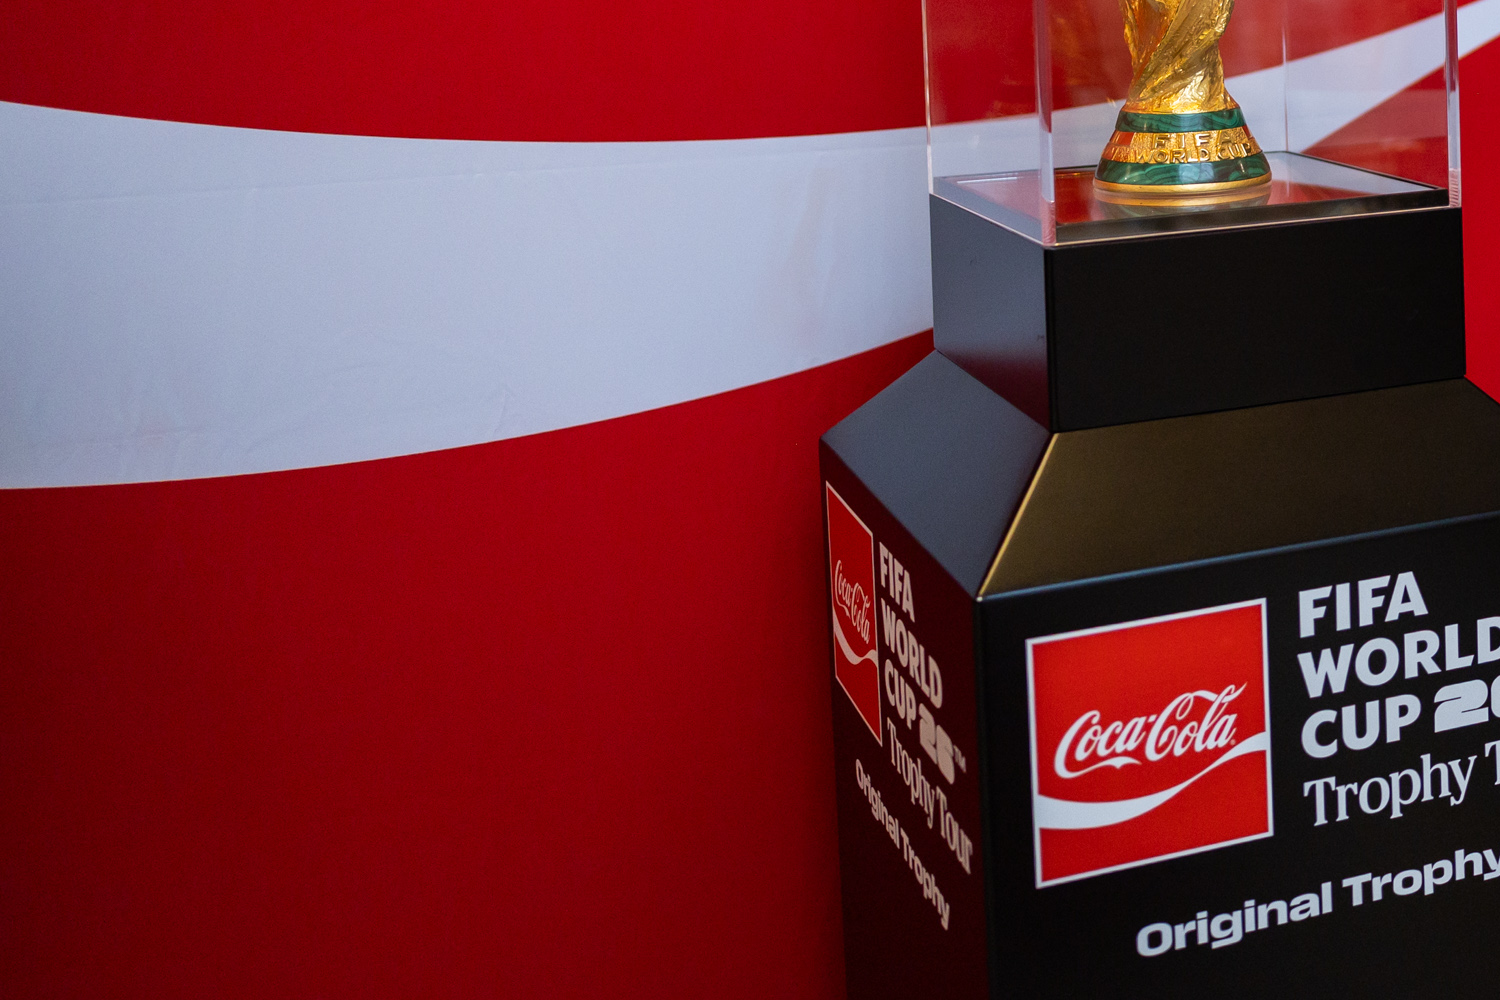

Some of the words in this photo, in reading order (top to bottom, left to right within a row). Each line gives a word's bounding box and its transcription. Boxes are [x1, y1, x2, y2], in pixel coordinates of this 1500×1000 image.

[1134, 147, 1210, 163] WORLD
[1217, 142, 1252, 160] CUP
[1153, 132, 1236, 149] FIFA
[834, 559, 871, 645] Coca-Cola
[878, 541, 915, 623] FIFA
[1298, 571, 1429, 638] FIFA
[880, 597, 943, 709] WORLD
[884, 658, 917, 730] CUP
[1053, 681, 1248, 779] Coca-Cola
[1301, 694, 1421, 759] CUP
[886, 716, 935, 830] Trophy
[936, 785, 973, 875] Tour
[1303, 753, 1477, 827] Trophy
[855, 758, 900, 850] Original
[900, 827, 950, 931] Trophy
[1136, 882, 1333, 957] Original
